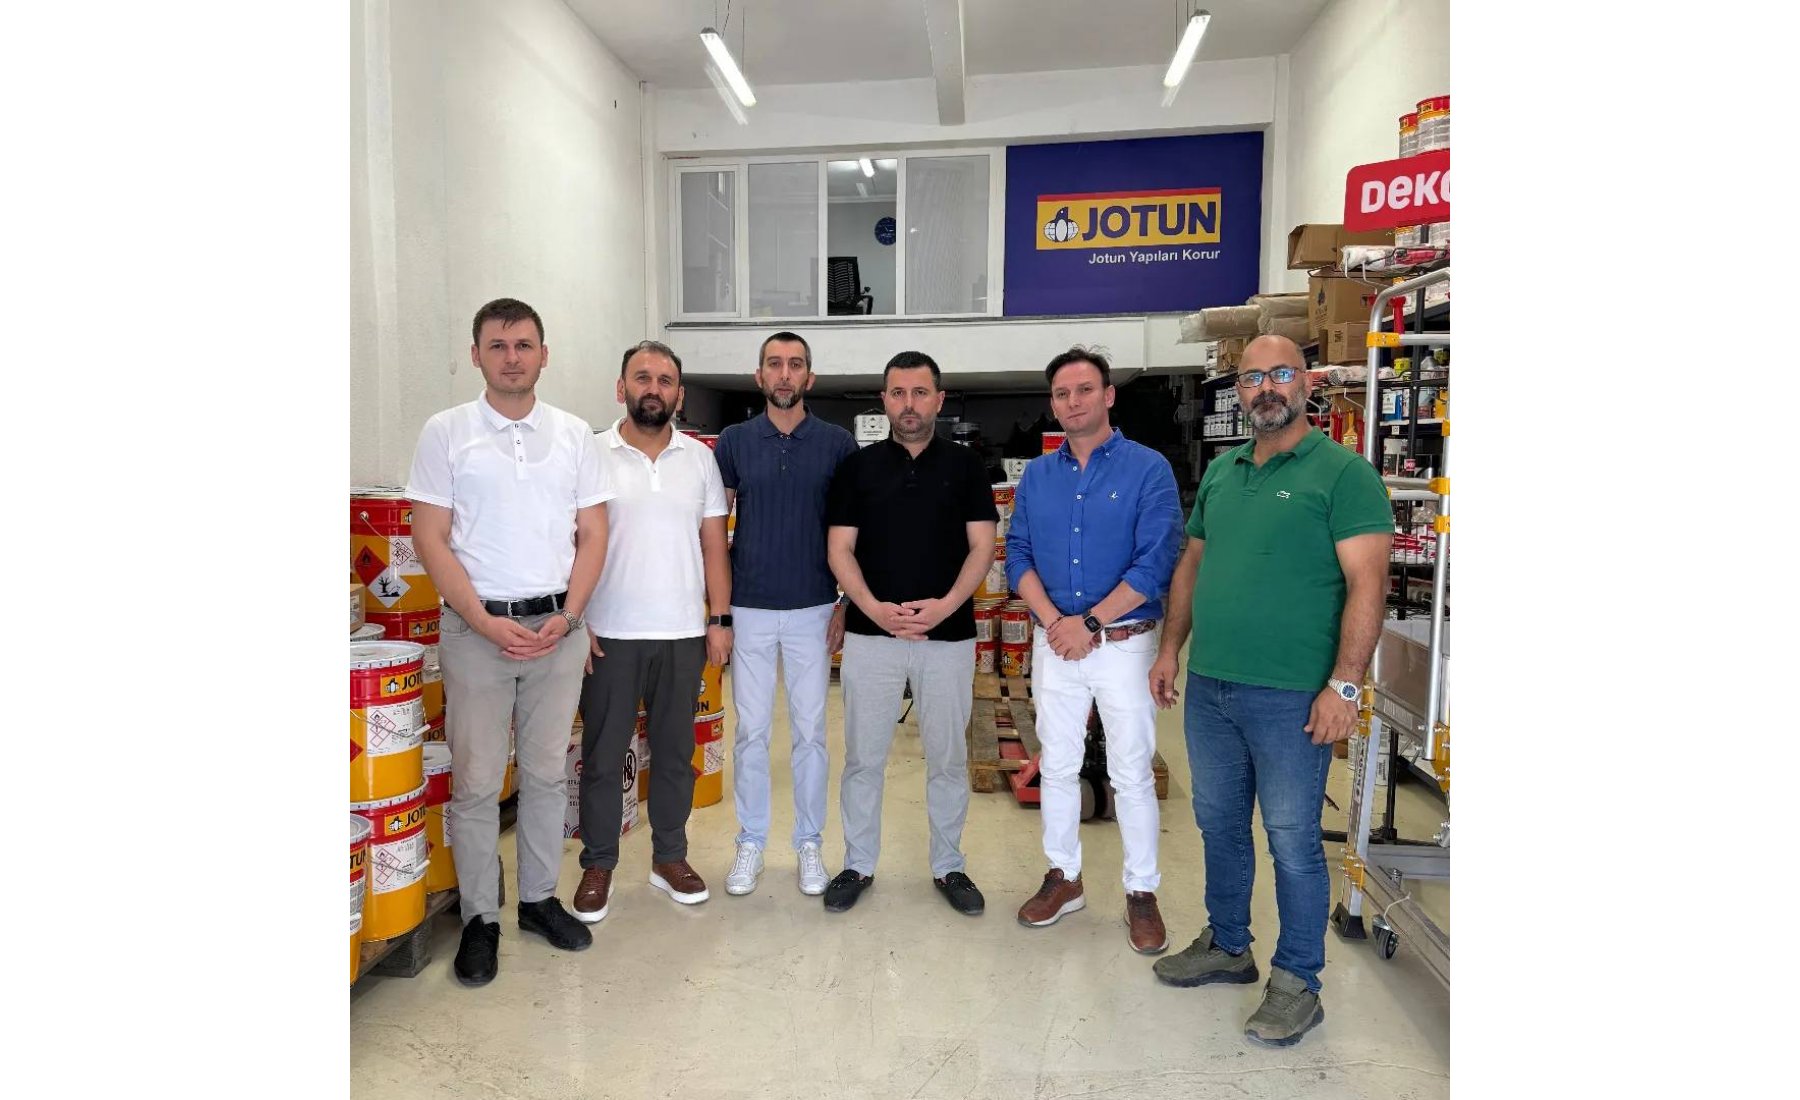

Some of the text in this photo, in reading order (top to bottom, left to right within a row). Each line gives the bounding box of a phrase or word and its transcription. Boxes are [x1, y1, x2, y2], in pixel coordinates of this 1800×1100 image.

[1082, 201, 1217, 242] JOTUN
[1088, 248, 1221, 265] Jotun Yapıları Korur
